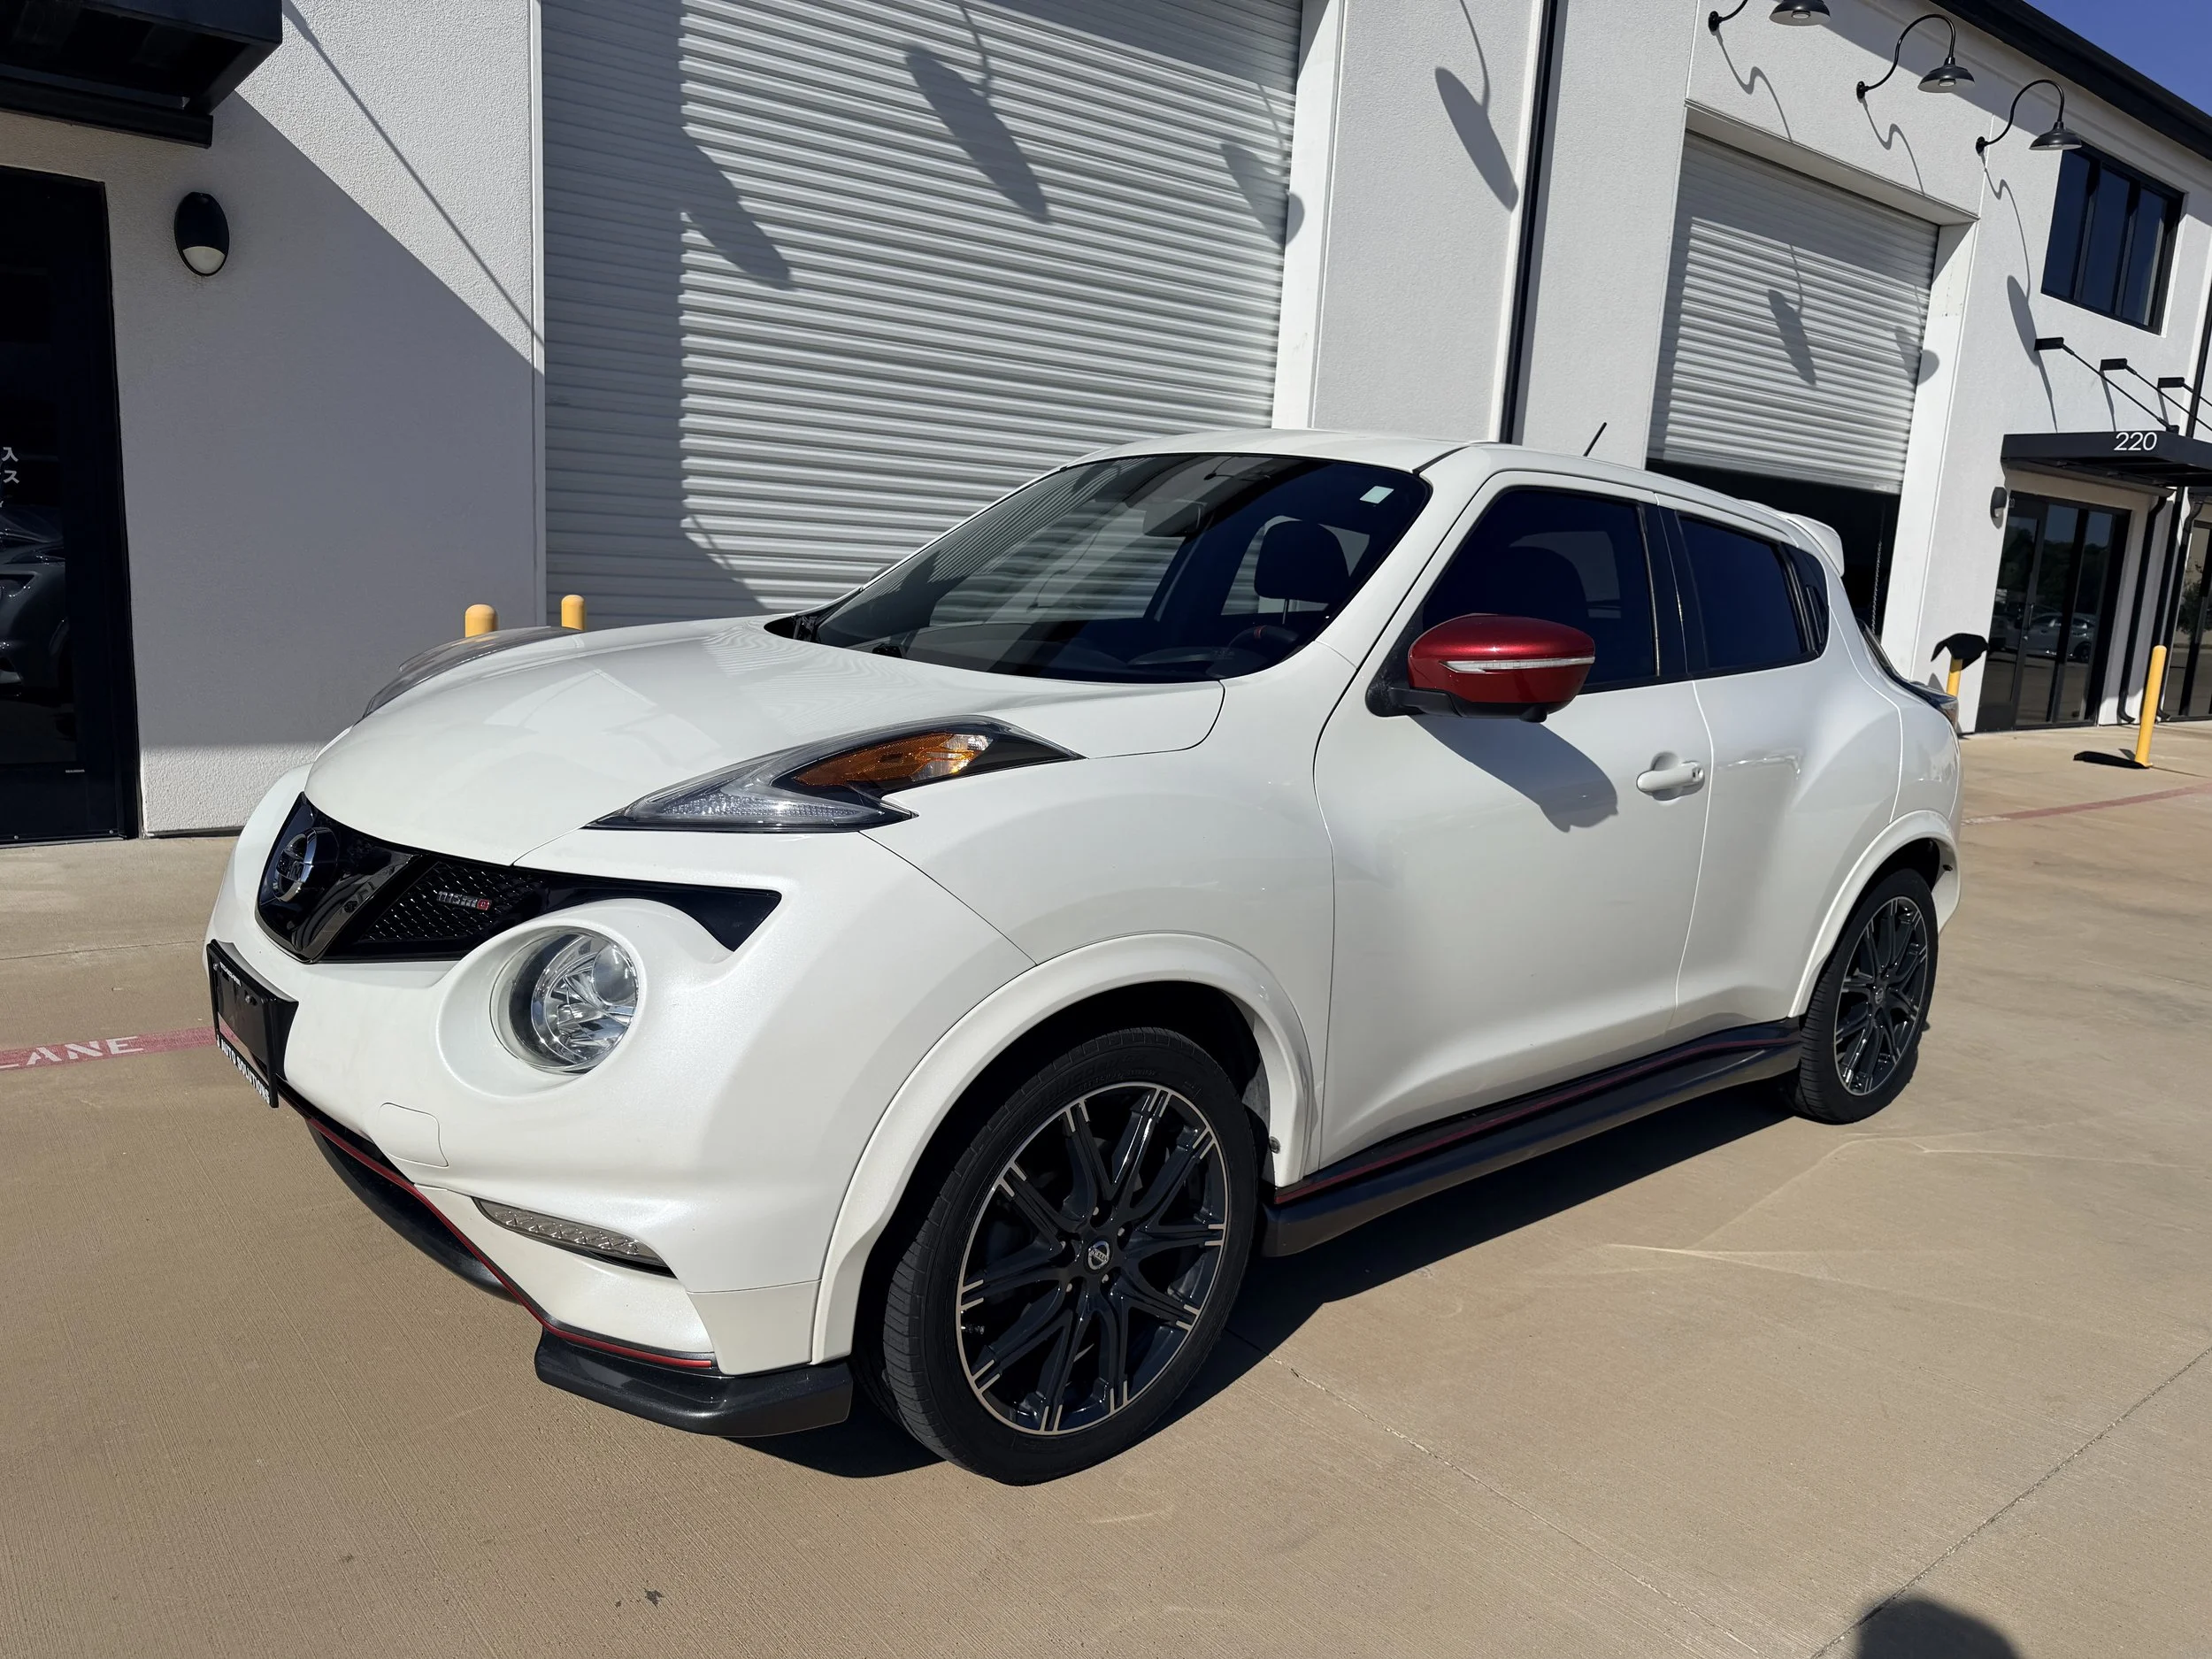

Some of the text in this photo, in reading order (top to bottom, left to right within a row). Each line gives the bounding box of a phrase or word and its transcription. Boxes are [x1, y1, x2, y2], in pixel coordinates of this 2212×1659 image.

[2114, 432, 2158, 451] 220
[221, 1039, 236, 1064] AUTO
[236, 1056, 271, 1105] SOLUTIONS
